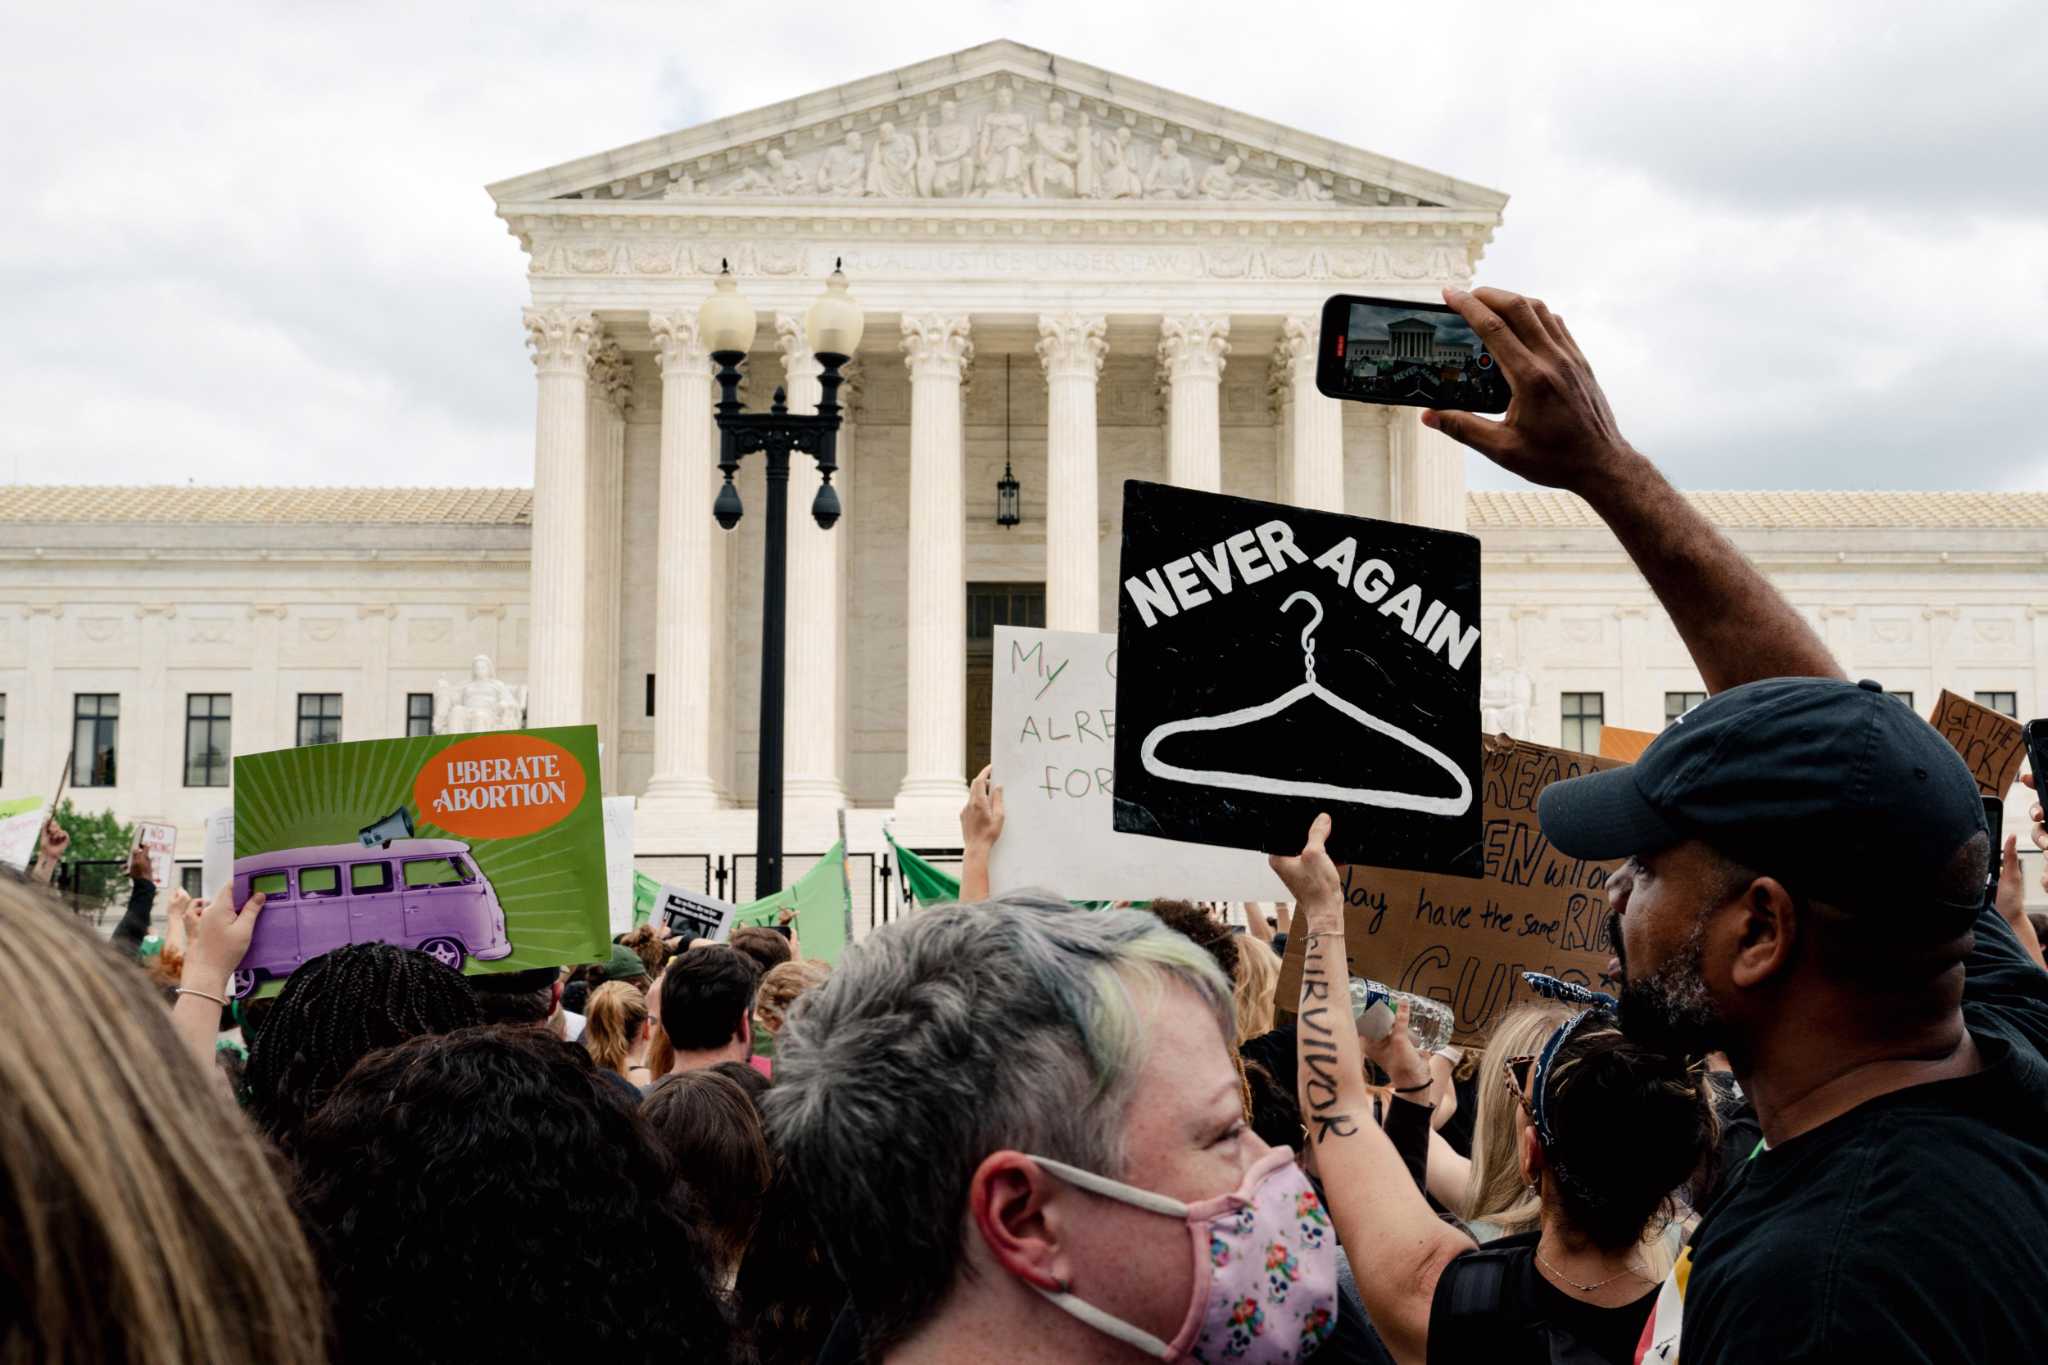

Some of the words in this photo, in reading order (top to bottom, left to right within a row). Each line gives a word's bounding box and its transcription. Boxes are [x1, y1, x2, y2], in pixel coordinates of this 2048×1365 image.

[1035, 252, 1120, 272] UNDER
[1130, 252, 1178, 272] LAW
[1124, 519, 1309, 628] NEVER
[1313, 536, 1480, 671] AGAIN
[1946, 700, 1988, 732] GET
[1986, 714, 2023, 751] THE
[447, 755, 561, 785] LIBERATE
[432, 780, 566, 813] ABORTION
[1416, 888, 1471, 929] have
[1480, 900, 1513, 932] the
[1517, 913, 1560, 944] same
